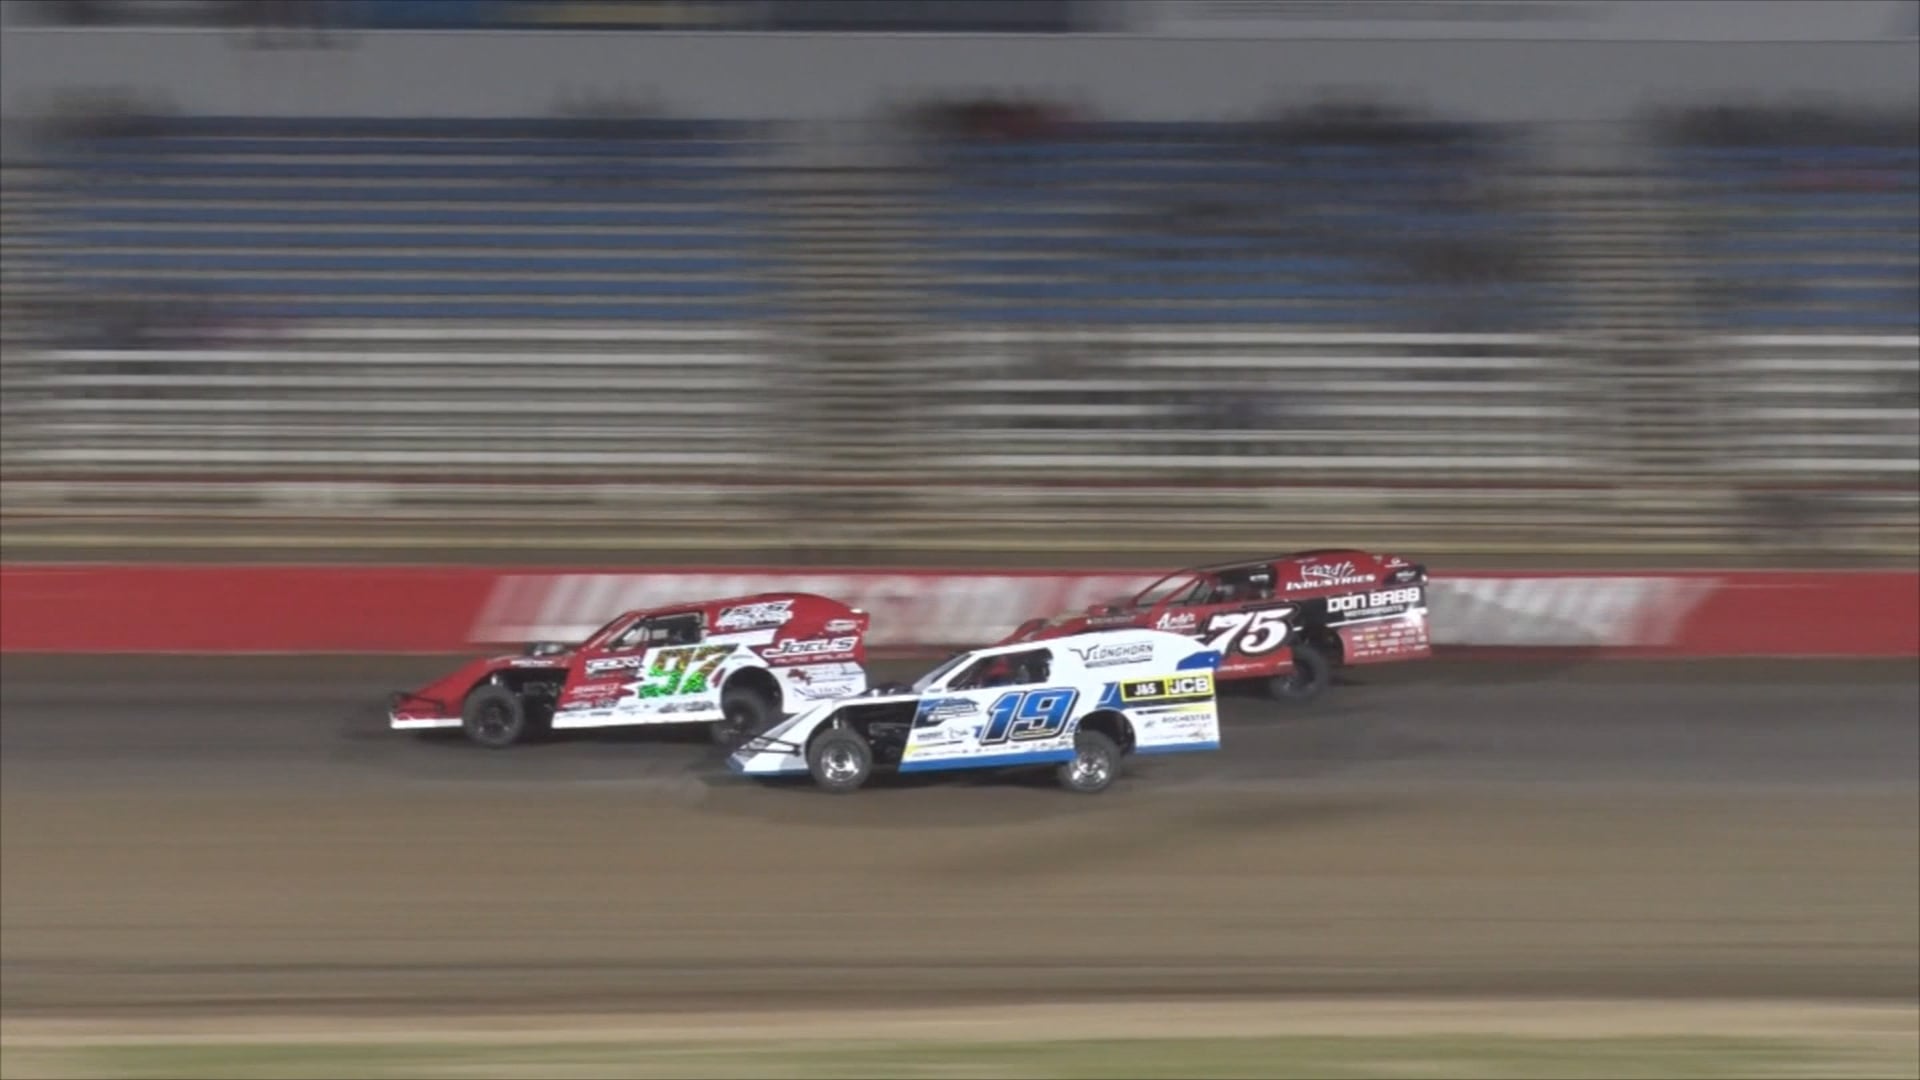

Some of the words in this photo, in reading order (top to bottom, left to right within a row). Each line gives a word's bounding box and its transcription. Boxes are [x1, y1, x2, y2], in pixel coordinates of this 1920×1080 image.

[1286, 574, 1376, 591] INDUSTRIES
[1370, 587, 1421, 607] BABB
[1207, 608, 1293, 654] 75
[1092, 643, 1154, 661] LONGHORN
[1170, 677, 1209, 694] JCB
[980, 688, 1079, 745] 19
